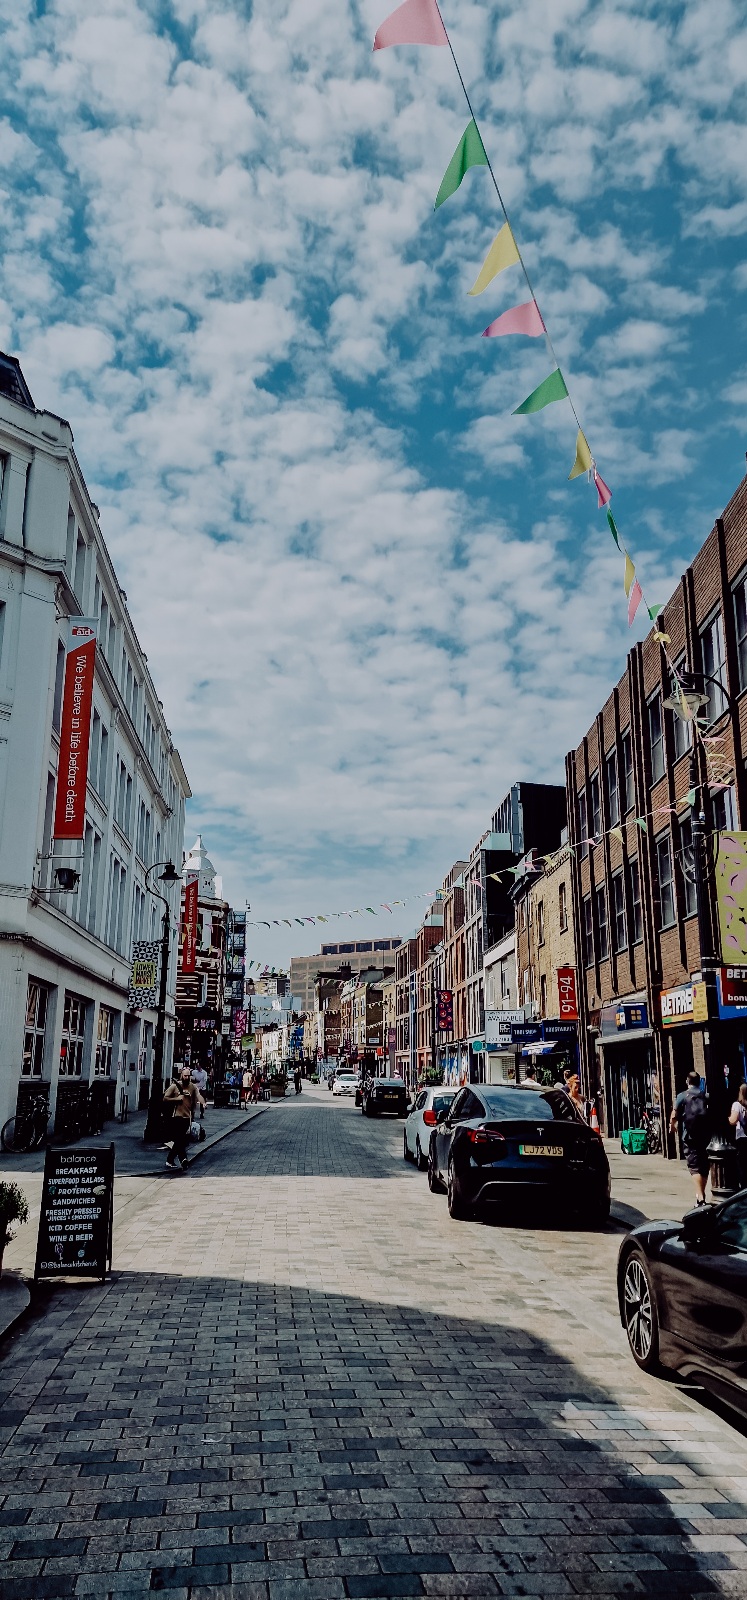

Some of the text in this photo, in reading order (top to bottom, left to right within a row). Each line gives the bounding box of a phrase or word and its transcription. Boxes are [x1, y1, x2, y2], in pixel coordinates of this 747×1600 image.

[64, 655, 87, 823] We believe in life before death
[560, 976, 575, 1013] 91-94
[660, 988, 694, 1017] BETFRE
[60, 1154, 97, 1163] balance
[55, 1166, 98, 1175] BREAKFAST
[48, 1176, 105, 1185] SUPERFOOD SALADS
[57, 1187, 92, 1195] PROTEINS
[52, 1197, 96, 1206] SANDWICHES
[45, 1207, 102, 1216] FRESHLY PRESSED
[48, 1223, 93, 1232] ICED COFFEE
[49, 1234, 68, 1242] WINE
[75, 1233, 94, 1241] BEER
